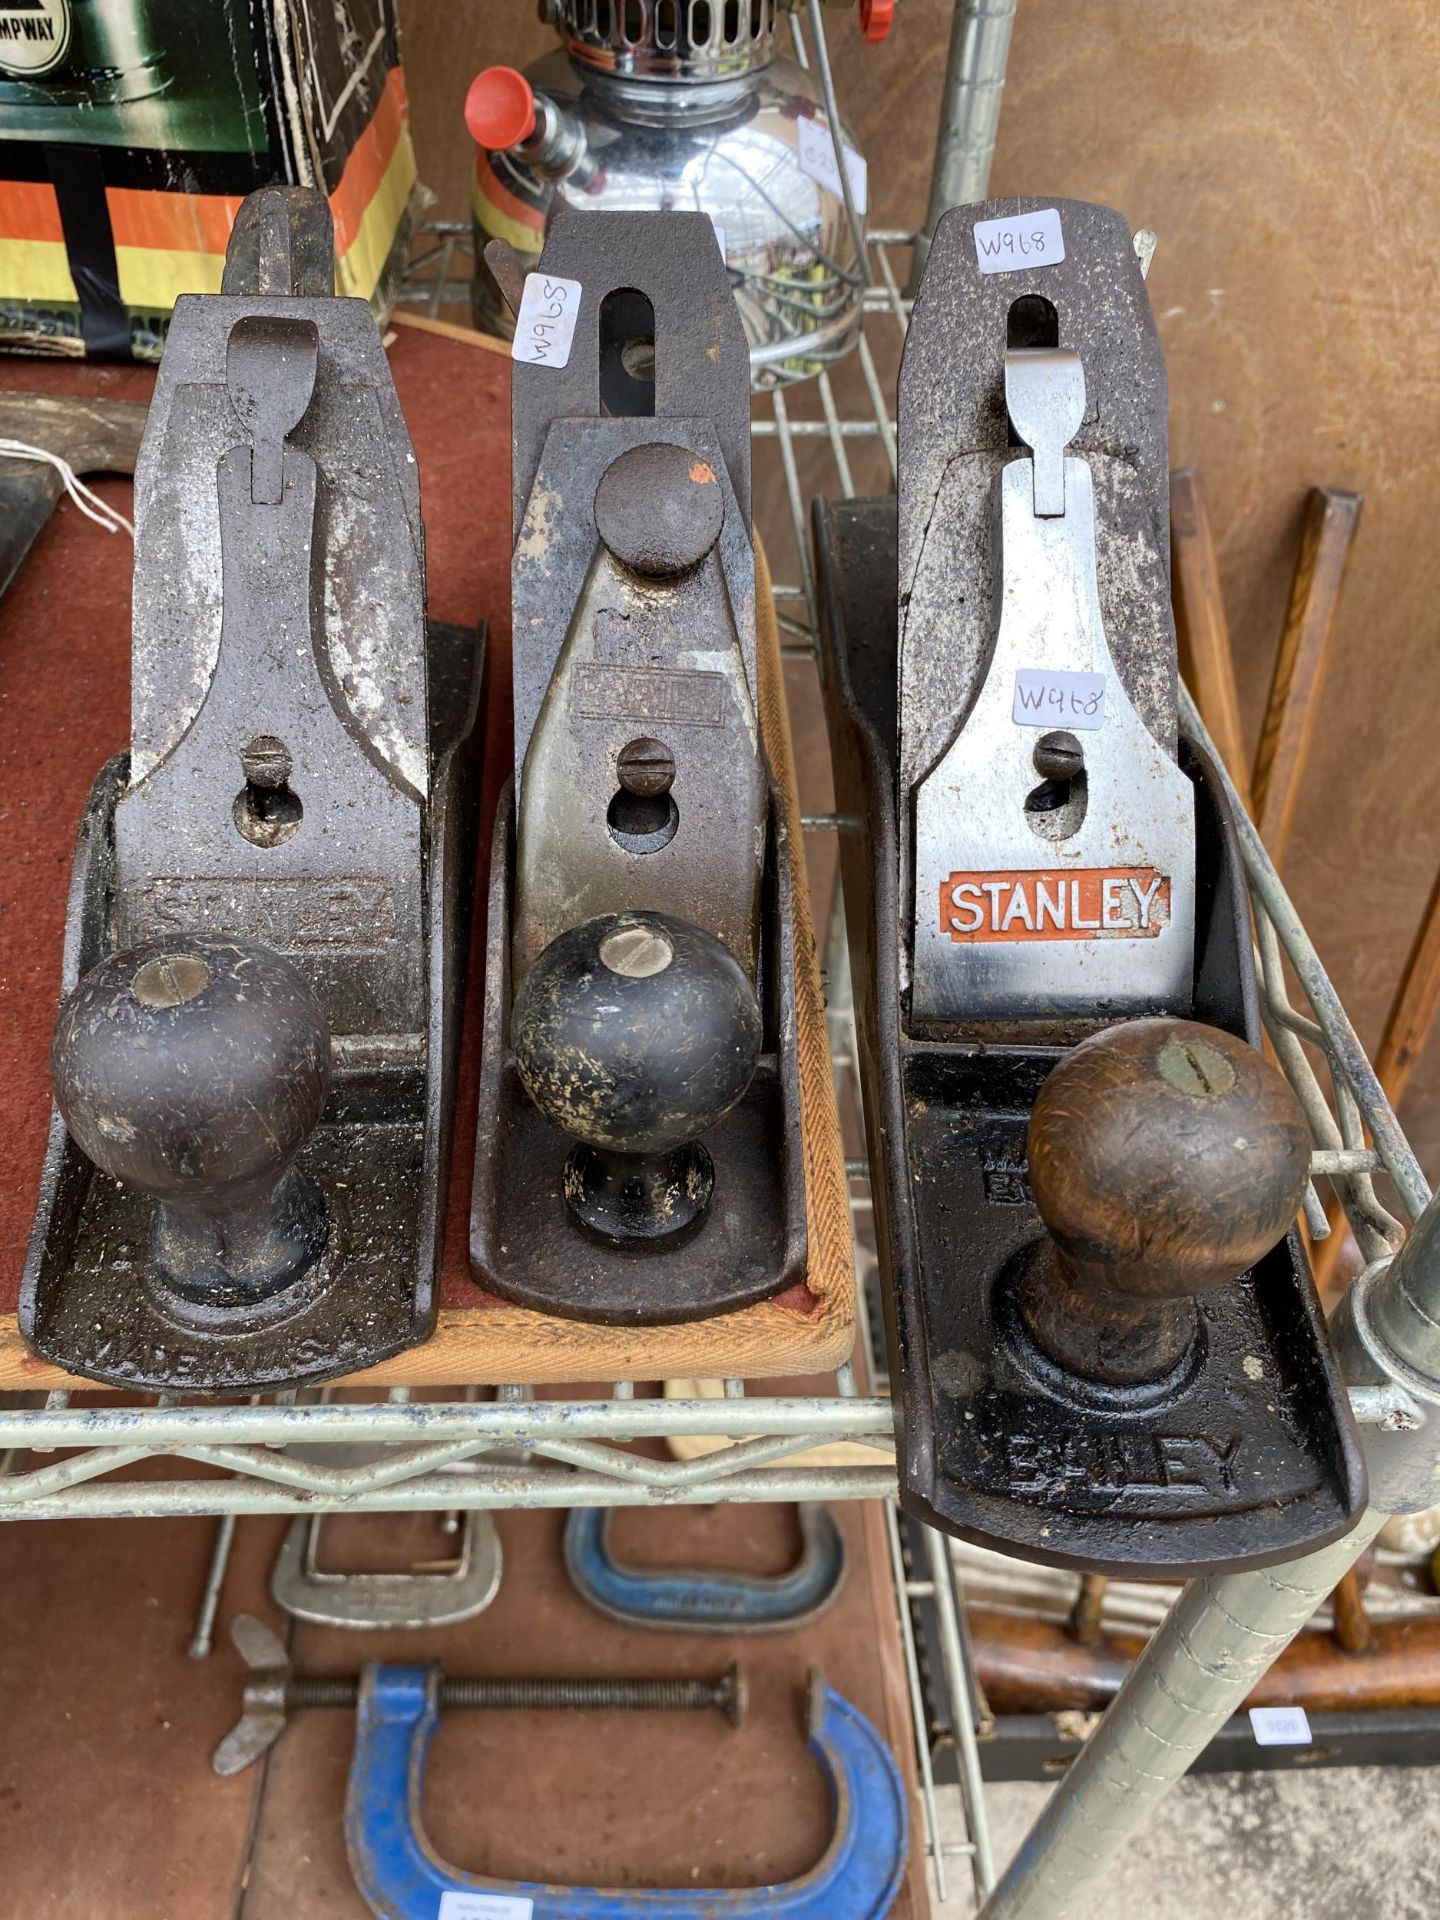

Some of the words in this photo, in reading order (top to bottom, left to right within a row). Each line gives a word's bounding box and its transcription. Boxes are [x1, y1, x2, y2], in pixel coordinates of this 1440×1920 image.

[978, 230, 1046, 256] W968
[1017, 684, 1104, 716] W968
[950, 877, 1162, 932] STANLEY
[1008, 1433, 1242, 1496] BAILEY
